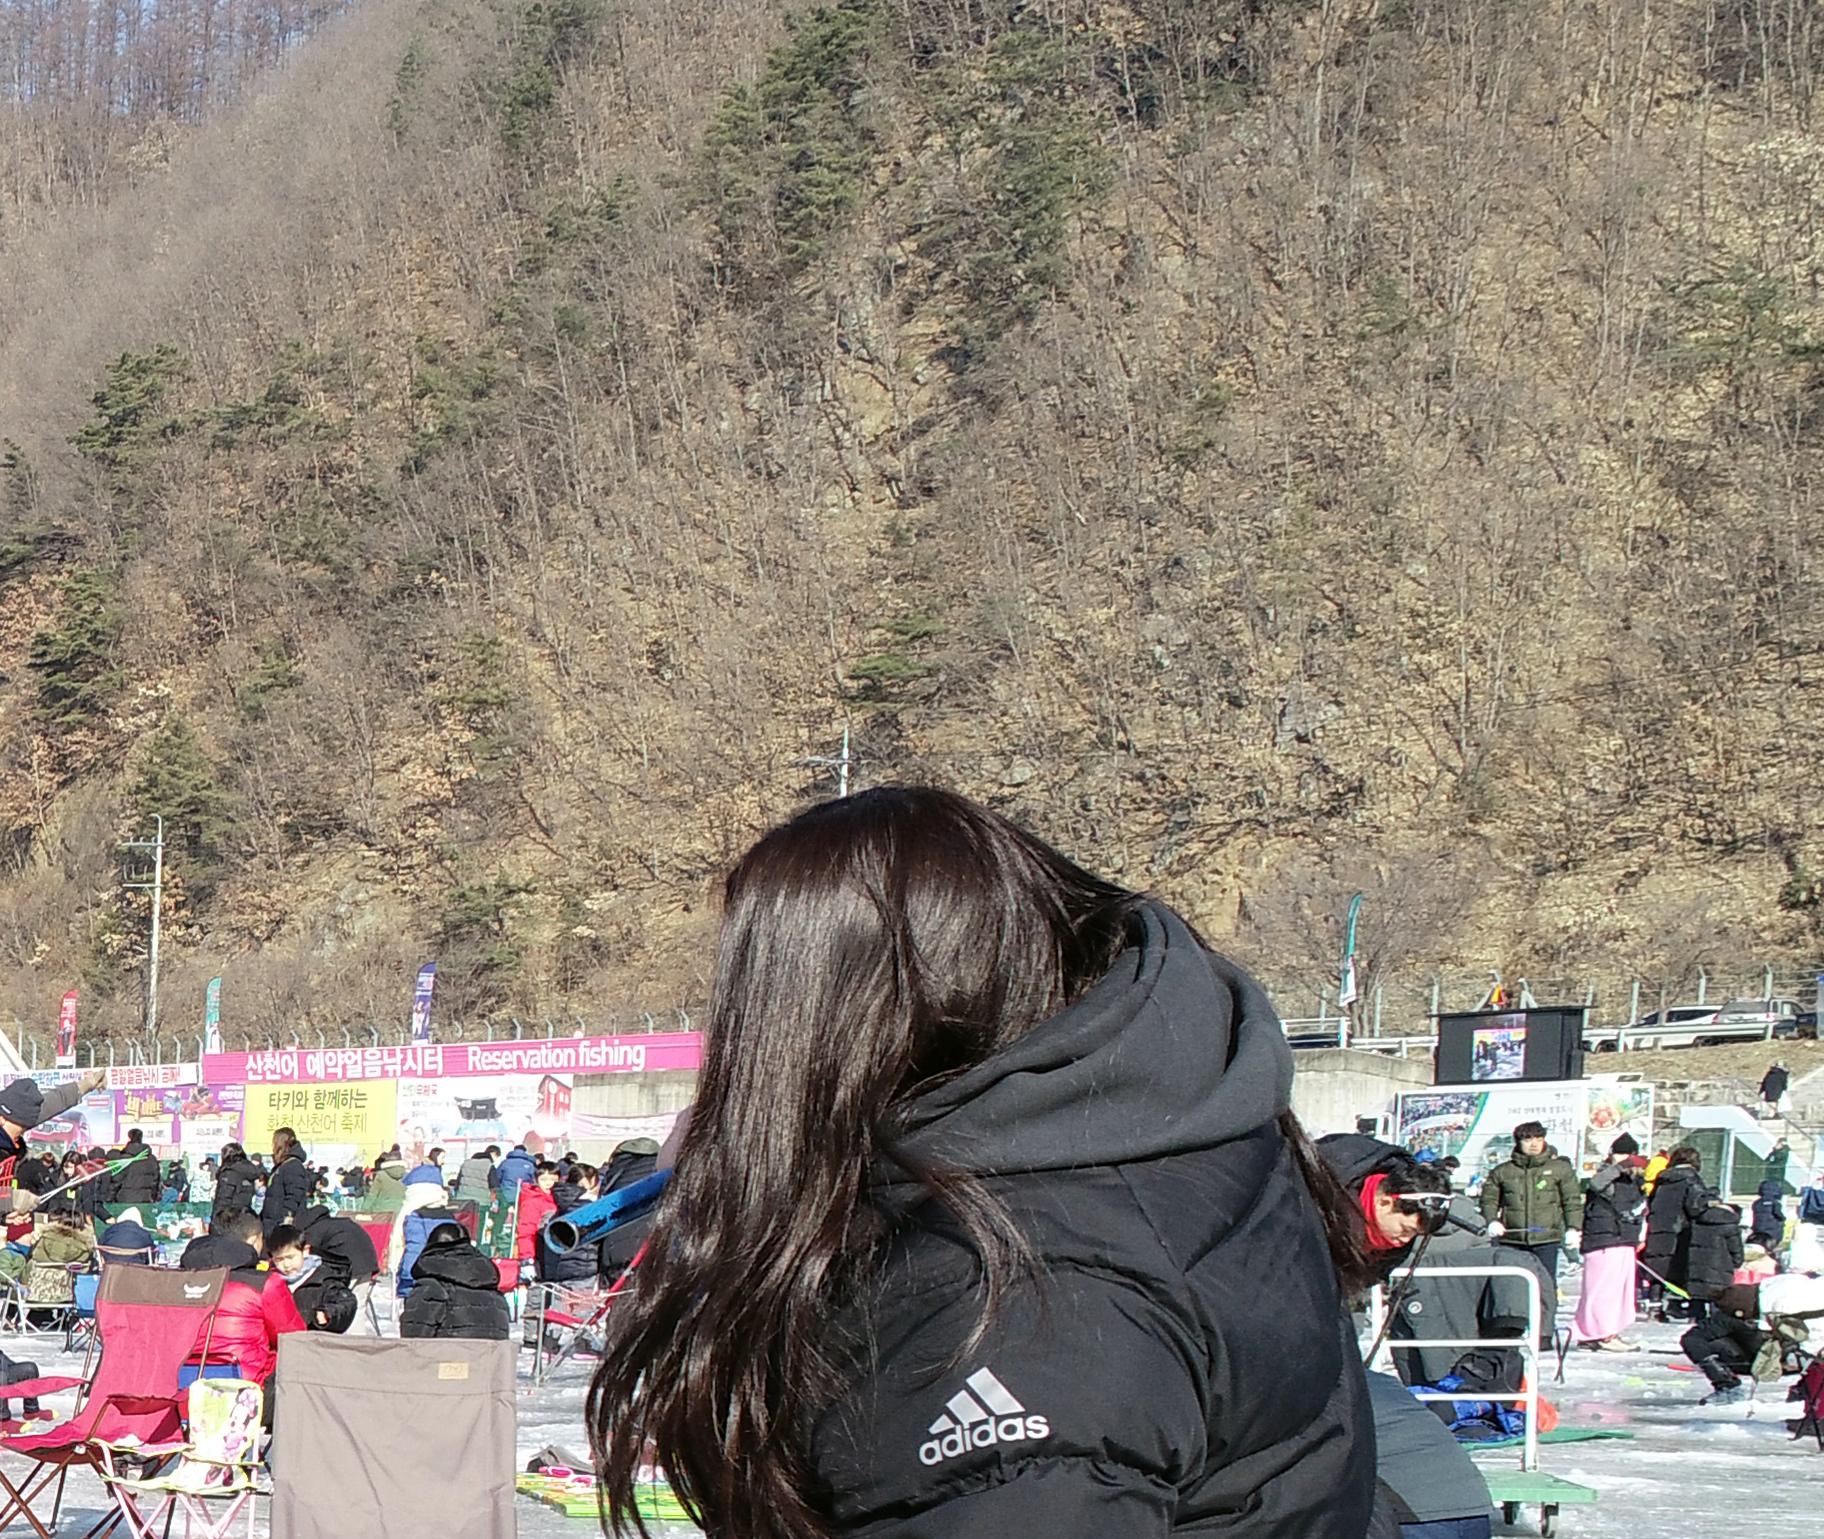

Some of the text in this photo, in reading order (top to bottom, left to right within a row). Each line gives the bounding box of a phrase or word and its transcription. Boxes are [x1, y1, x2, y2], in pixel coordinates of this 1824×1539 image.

[244, 1045, 444, 1081] 산천어 예약얼음낚시터
[467, 1038, 646, 1073] Reservation fishing
[268, 1089, 309, 1111] 타키와
[313, 1087, 369, 1111] 함께하는
[296, 1111, 337, 1134] 산천어
[340, 1111, 368, 1134] 축제
[918, 1414, 1050, 1466] adidas
